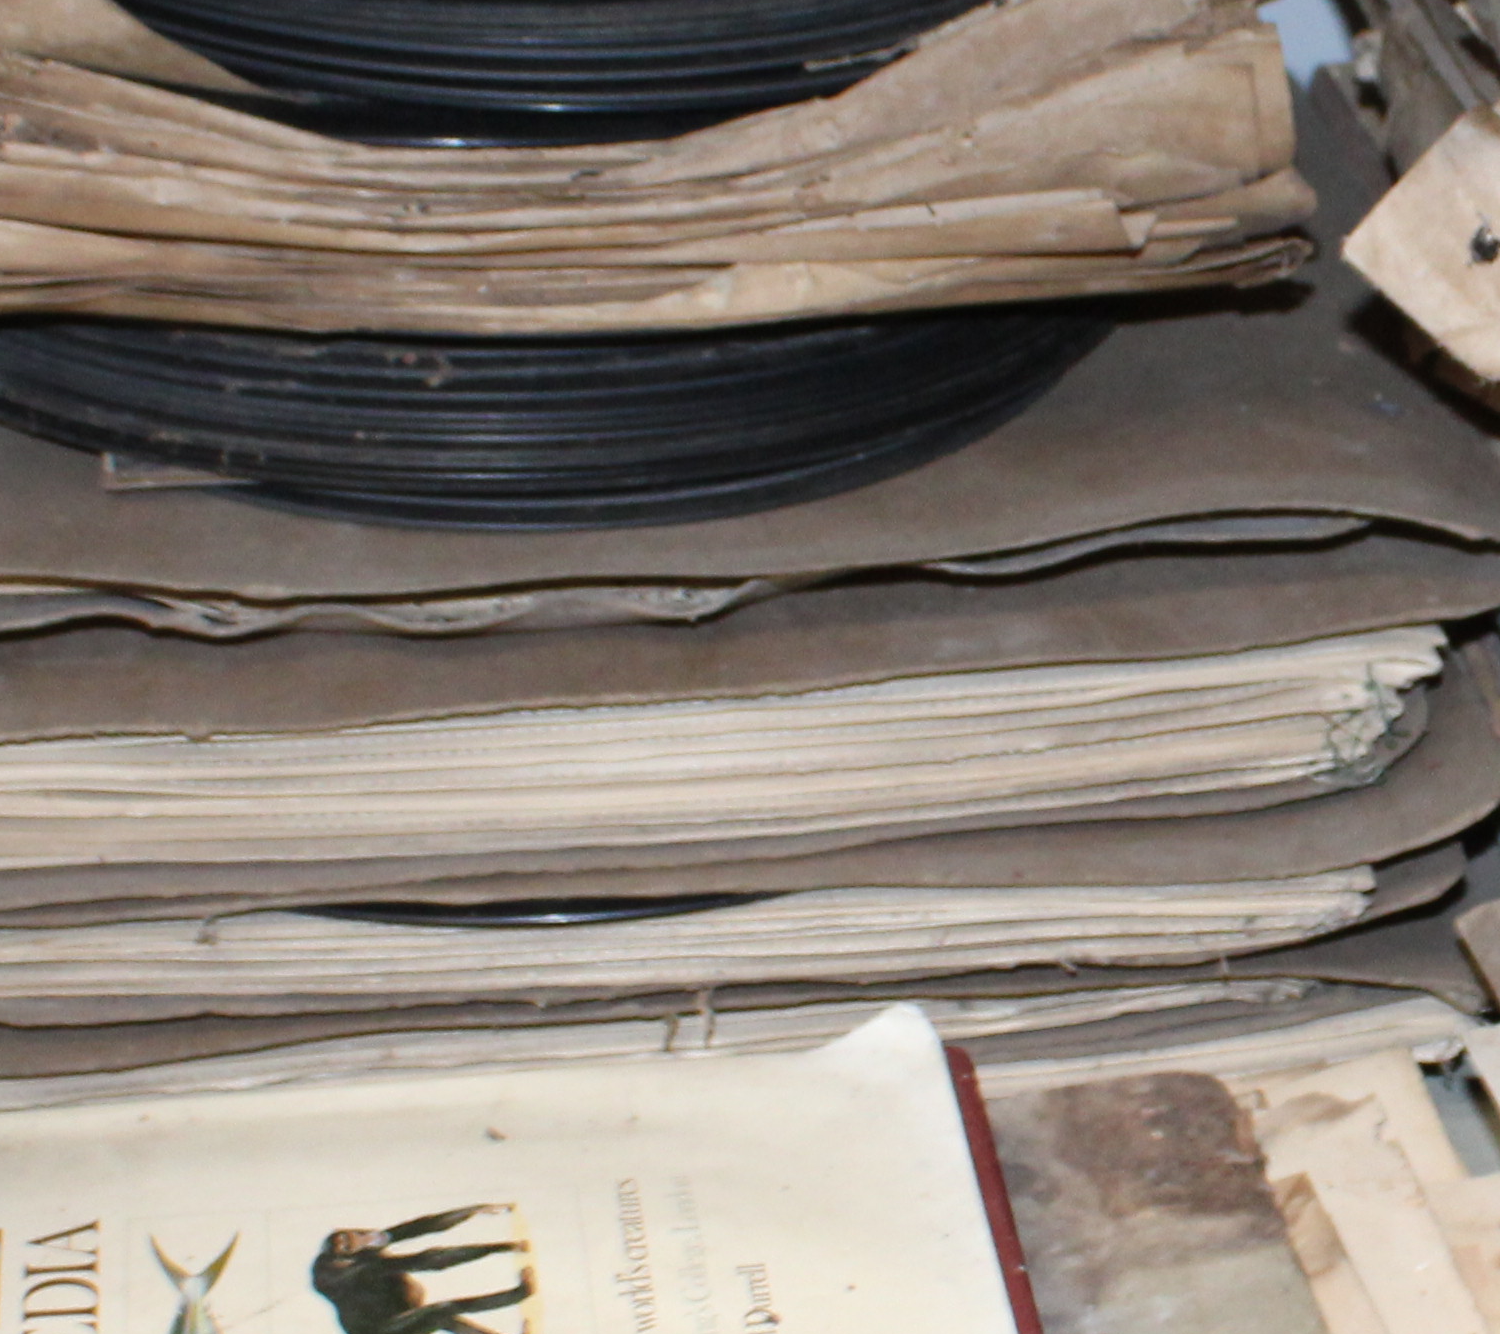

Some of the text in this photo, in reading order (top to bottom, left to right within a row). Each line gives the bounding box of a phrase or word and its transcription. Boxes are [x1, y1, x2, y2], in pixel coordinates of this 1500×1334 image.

[615, 1177, 649, 1260] creatures
[614, 1264, 658, 1334] world's
[734, 1262, 781, 1328] Durrell
